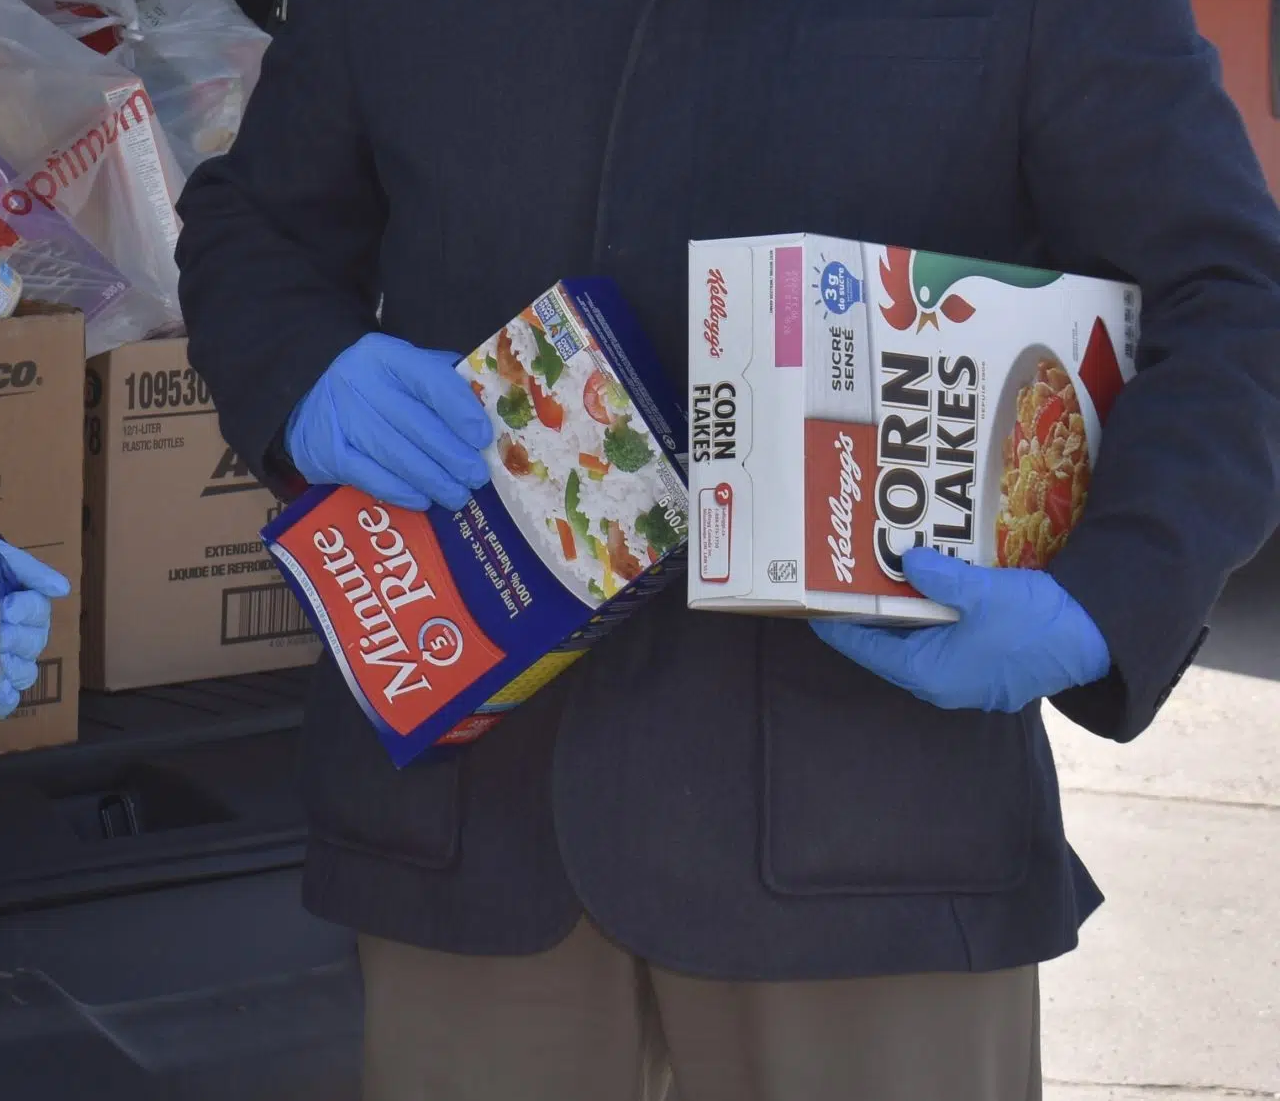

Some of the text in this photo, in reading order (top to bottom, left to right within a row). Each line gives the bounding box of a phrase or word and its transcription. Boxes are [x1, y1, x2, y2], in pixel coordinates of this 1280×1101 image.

[703, 268, 729, 359] Kellogg's
[825, 274, 838, 301] 3 g
[837, 268, 846, 310] de sucre
[561, 337, 573, 356] GMO
[829, 326, 842, 391] SUCRÉ
[842, 328, 855, 392] SENSÉ
[122, 437, 185, 453] PLASTIC BOTTLES
[693, 384, 711, 463] FLAKES
[714, 381, 737, 460] CORN
[876, 351, 930, 576] CORN
[659, 494, 672, 508] g
[663, 508, 687, 534] 700
[827, 431, 862, 584] Kellogg's
[169, 565, 209, 581] LIQUIDE
[211, 563, 226, 577] DE
[205, 541, 263, 559] EXTENDED
[357, 506, 436, 615] Rice
[453, 511, 519, 619] Long grain rice Riz à
[467, 496, 533, 608] 100% Natural Natu
[313, 527, 433, 704] Minute
[430, 636, 448, 651] 5
